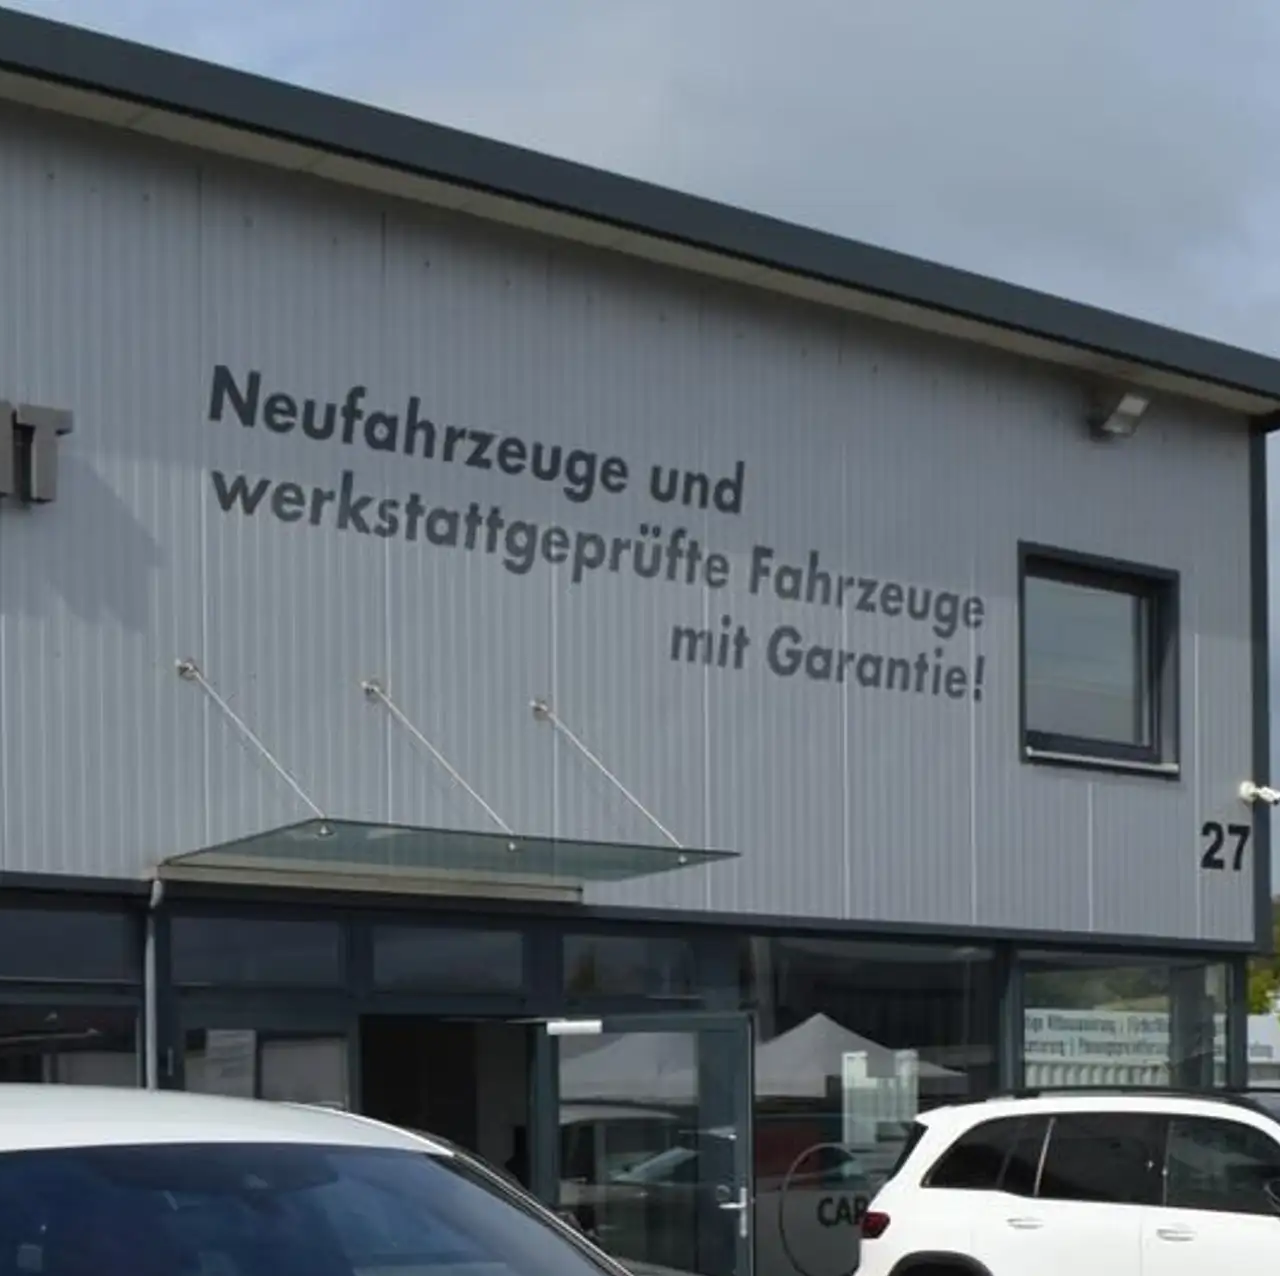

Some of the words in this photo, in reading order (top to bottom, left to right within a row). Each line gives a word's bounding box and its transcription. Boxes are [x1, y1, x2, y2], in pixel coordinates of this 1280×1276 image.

[207, 364, 629, 503] Neufahrzeuge
[649, 460, 746, 515] und
[210, 469, 731, 585] werkstattgeprüfte
[748, 545, 986, 640] Fahrzeuge
[669, 614, 751, 672] mit
[766, 624, 986, 702] Garantie!
[1200, 821, 1251, 871] 27
